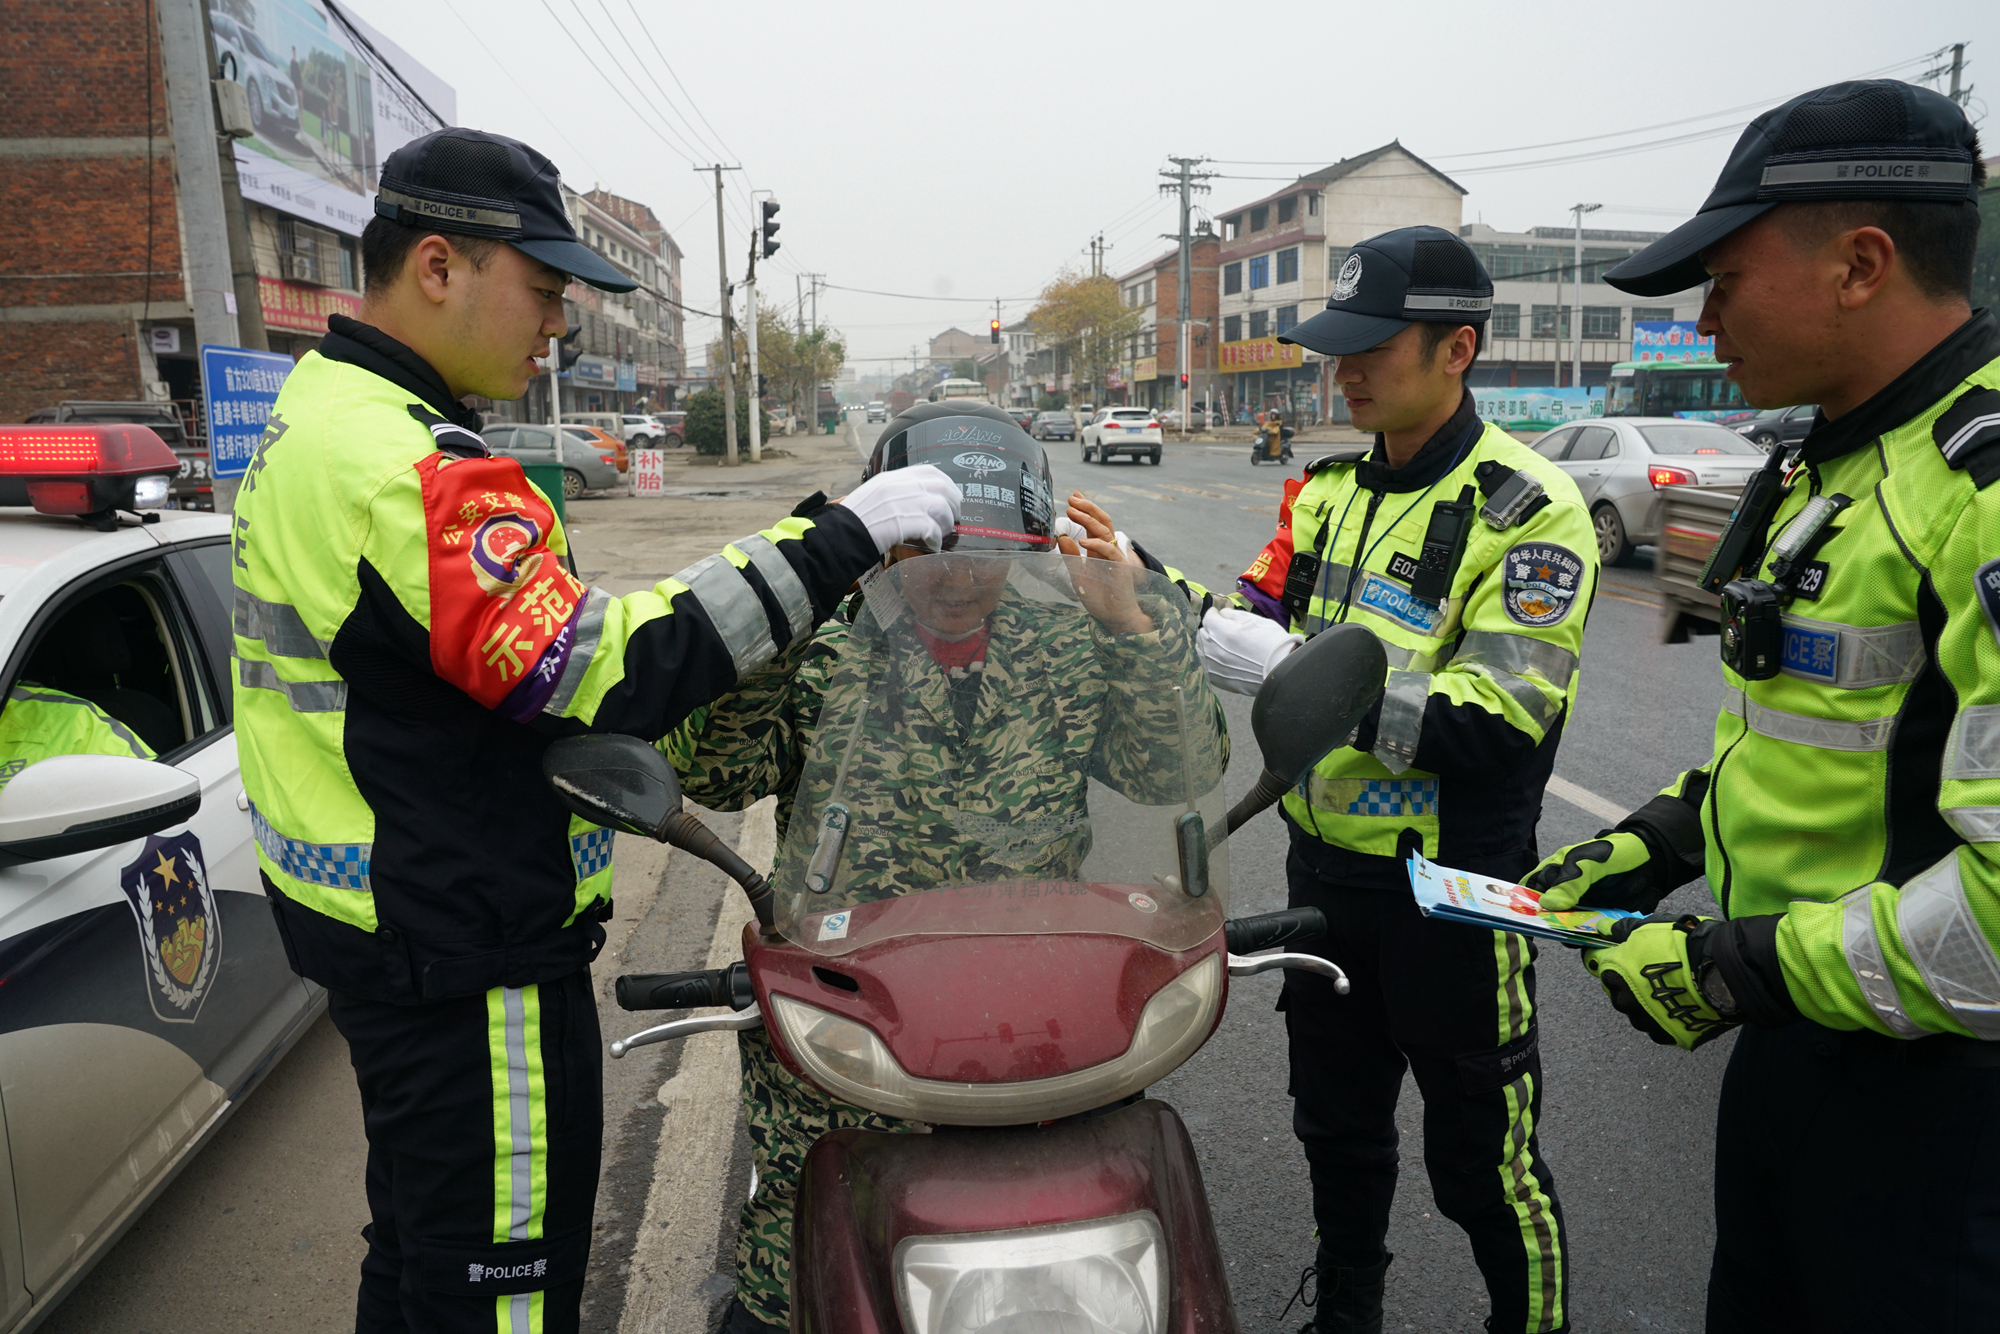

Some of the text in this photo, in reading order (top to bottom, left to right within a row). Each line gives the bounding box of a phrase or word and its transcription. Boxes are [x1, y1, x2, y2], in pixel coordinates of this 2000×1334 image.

[1837, 165, 1930, 177] 警 POLICE 察
[423, 202, 463, 218] POLICE
[1456, 299, 1478, 308] POLICE
[1641, 332, 1715, 345] 人人都是国
[938, 426, 1002, 444] AOYANG
[958, 454, 1005, 469] AOYANG
[638, 451, 662, 490] 补胎
[442, 491, 527, 545] 公安交警
[1510, 549, 1580, 576] 中华人民共和国
[1525, 582, 1557, 596] POLICE
